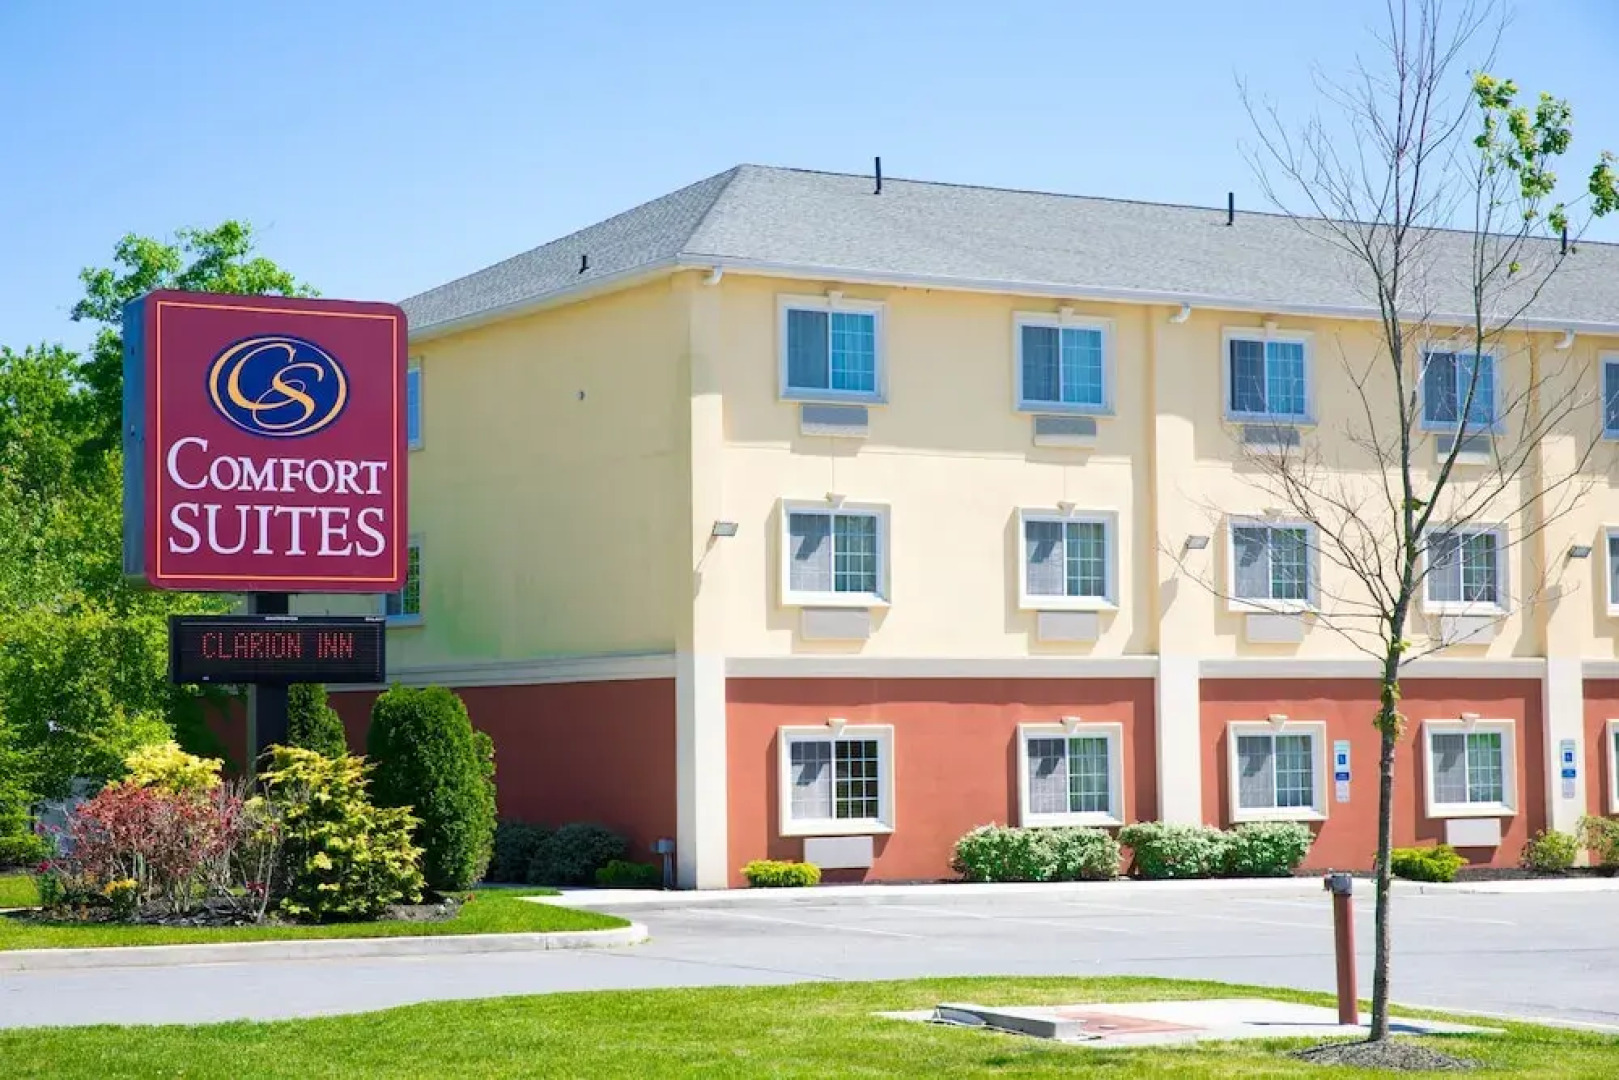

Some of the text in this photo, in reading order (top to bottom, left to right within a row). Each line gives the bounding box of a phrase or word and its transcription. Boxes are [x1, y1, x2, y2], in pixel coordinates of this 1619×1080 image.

[166, 436, 388, 495] COMFORT
[168, 502, 386, 558] SUITES
[202, 632, 353, 658] CLARION INN
